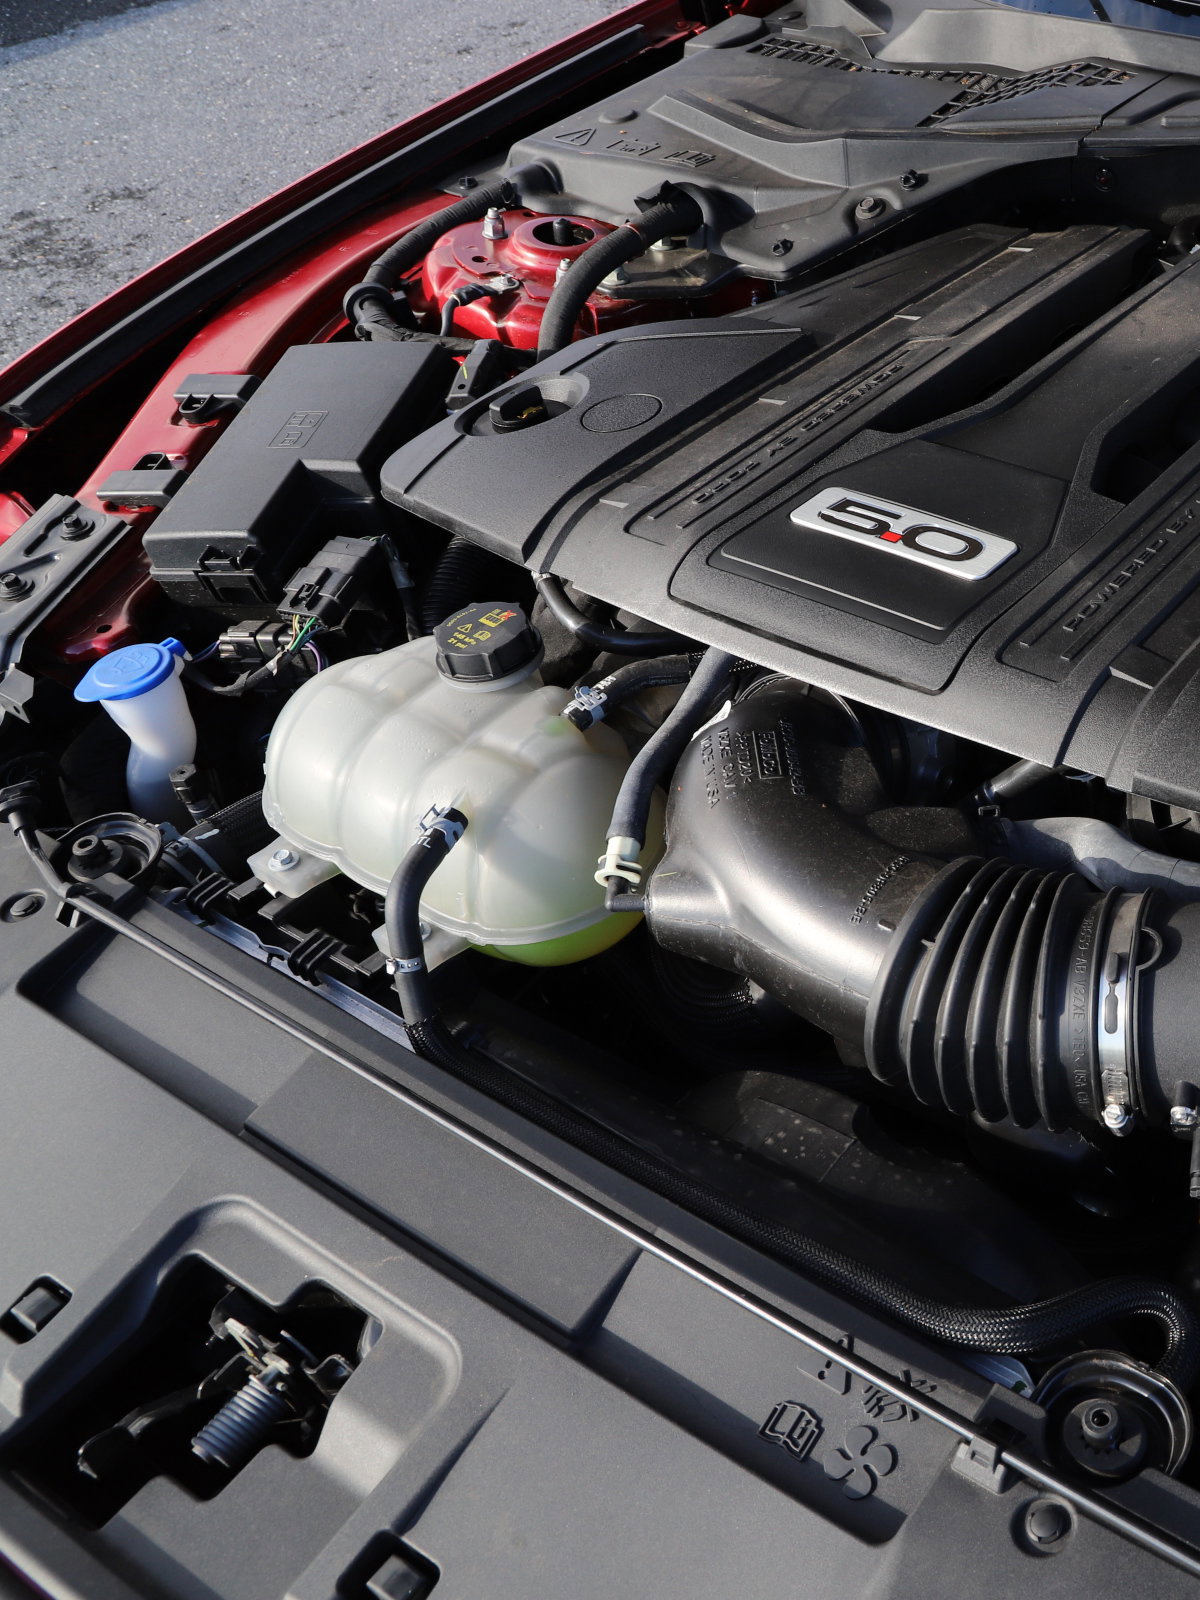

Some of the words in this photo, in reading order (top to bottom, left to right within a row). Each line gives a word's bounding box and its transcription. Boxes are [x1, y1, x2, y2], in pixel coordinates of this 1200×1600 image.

[802, 364, 903, 431] POWERED
[768, 436, 798, 457] BY
[693, 461, 761, 504] FORD
[818, 497, 984, 561] 5.0
[1063, 537, 1168, 632] POWERED
[1166, 507, 1195, 534] BY
